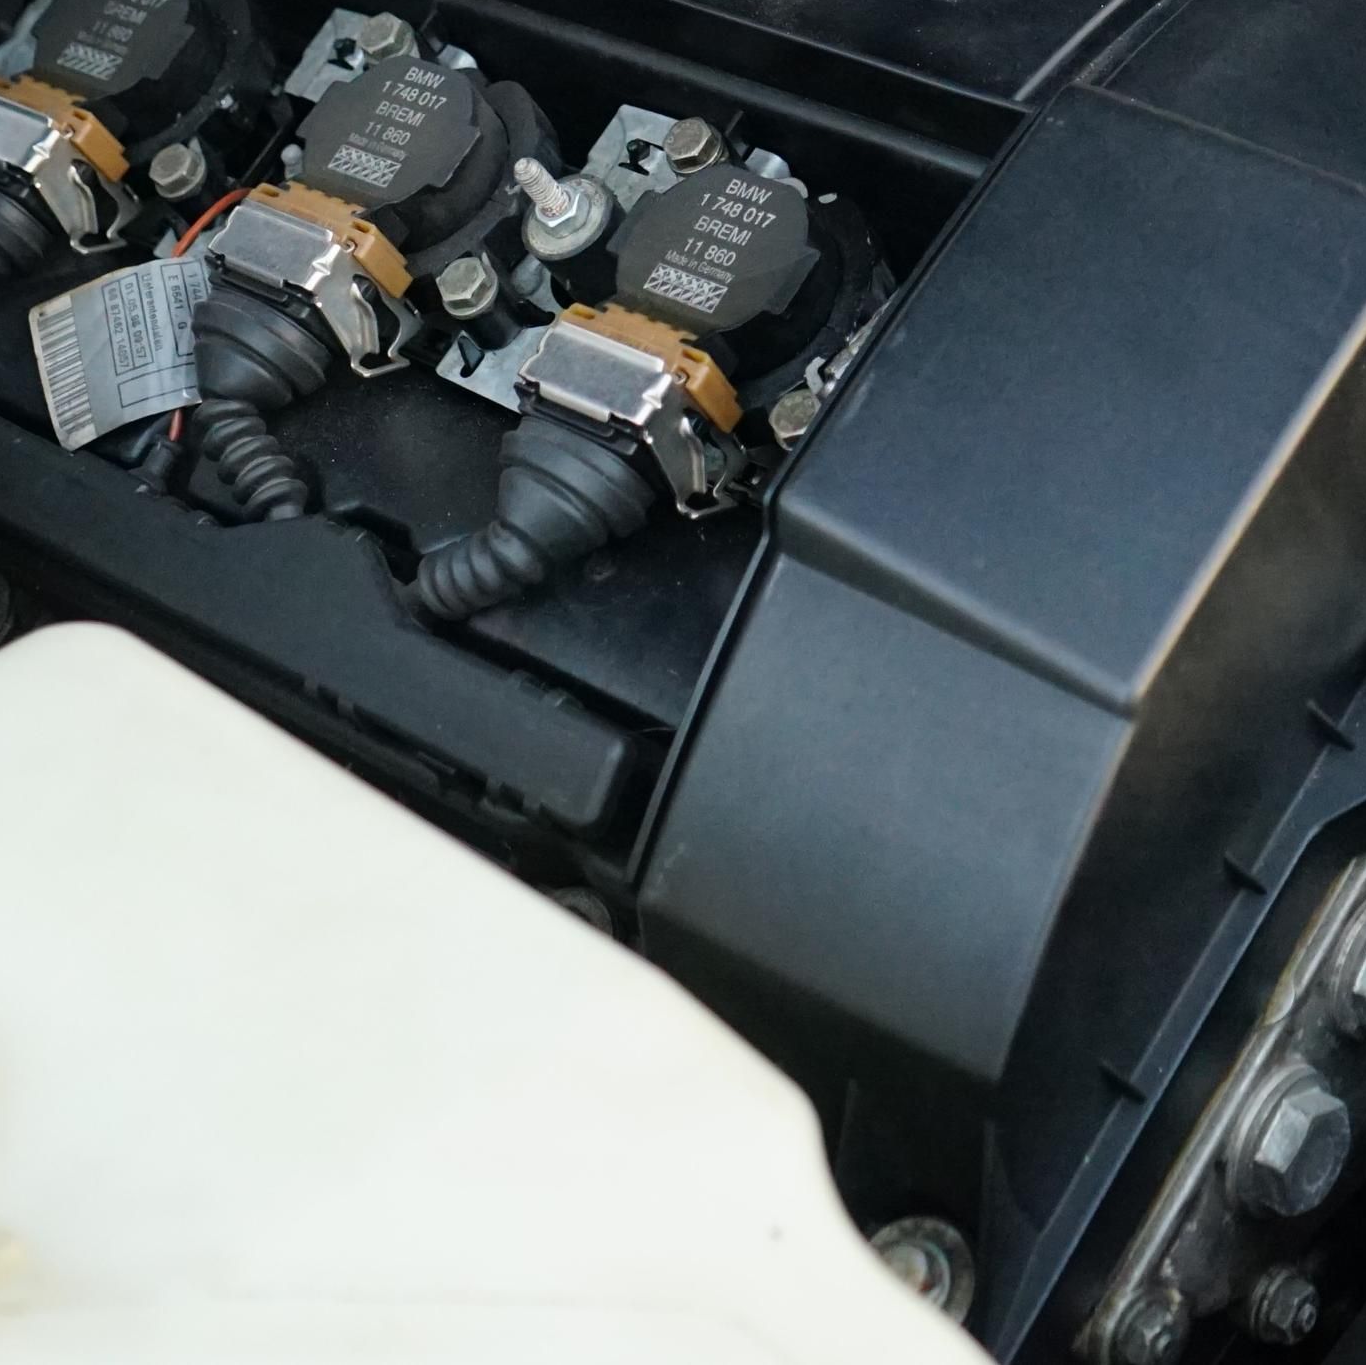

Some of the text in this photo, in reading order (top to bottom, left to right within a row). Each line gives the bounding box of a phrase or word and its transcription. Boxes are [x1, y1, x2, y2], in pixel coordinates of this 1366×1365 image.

[404, 66, 446, 89] BMW
[392, 83, 420, 102] 748
[418, 91, 447, 110] 017
[375, 101, 426, 127] BREMI
[382, 126, 411, 146] 860
[725, 178, 773, 205] BMW
[701, 193, 777, 228] 1 748 017
[693, 215, 752, 246] BREMI
[664, 249, 689, 266] Made
[697, 261, 736, 284] Germany
[704, 245, 736, 266] 860
